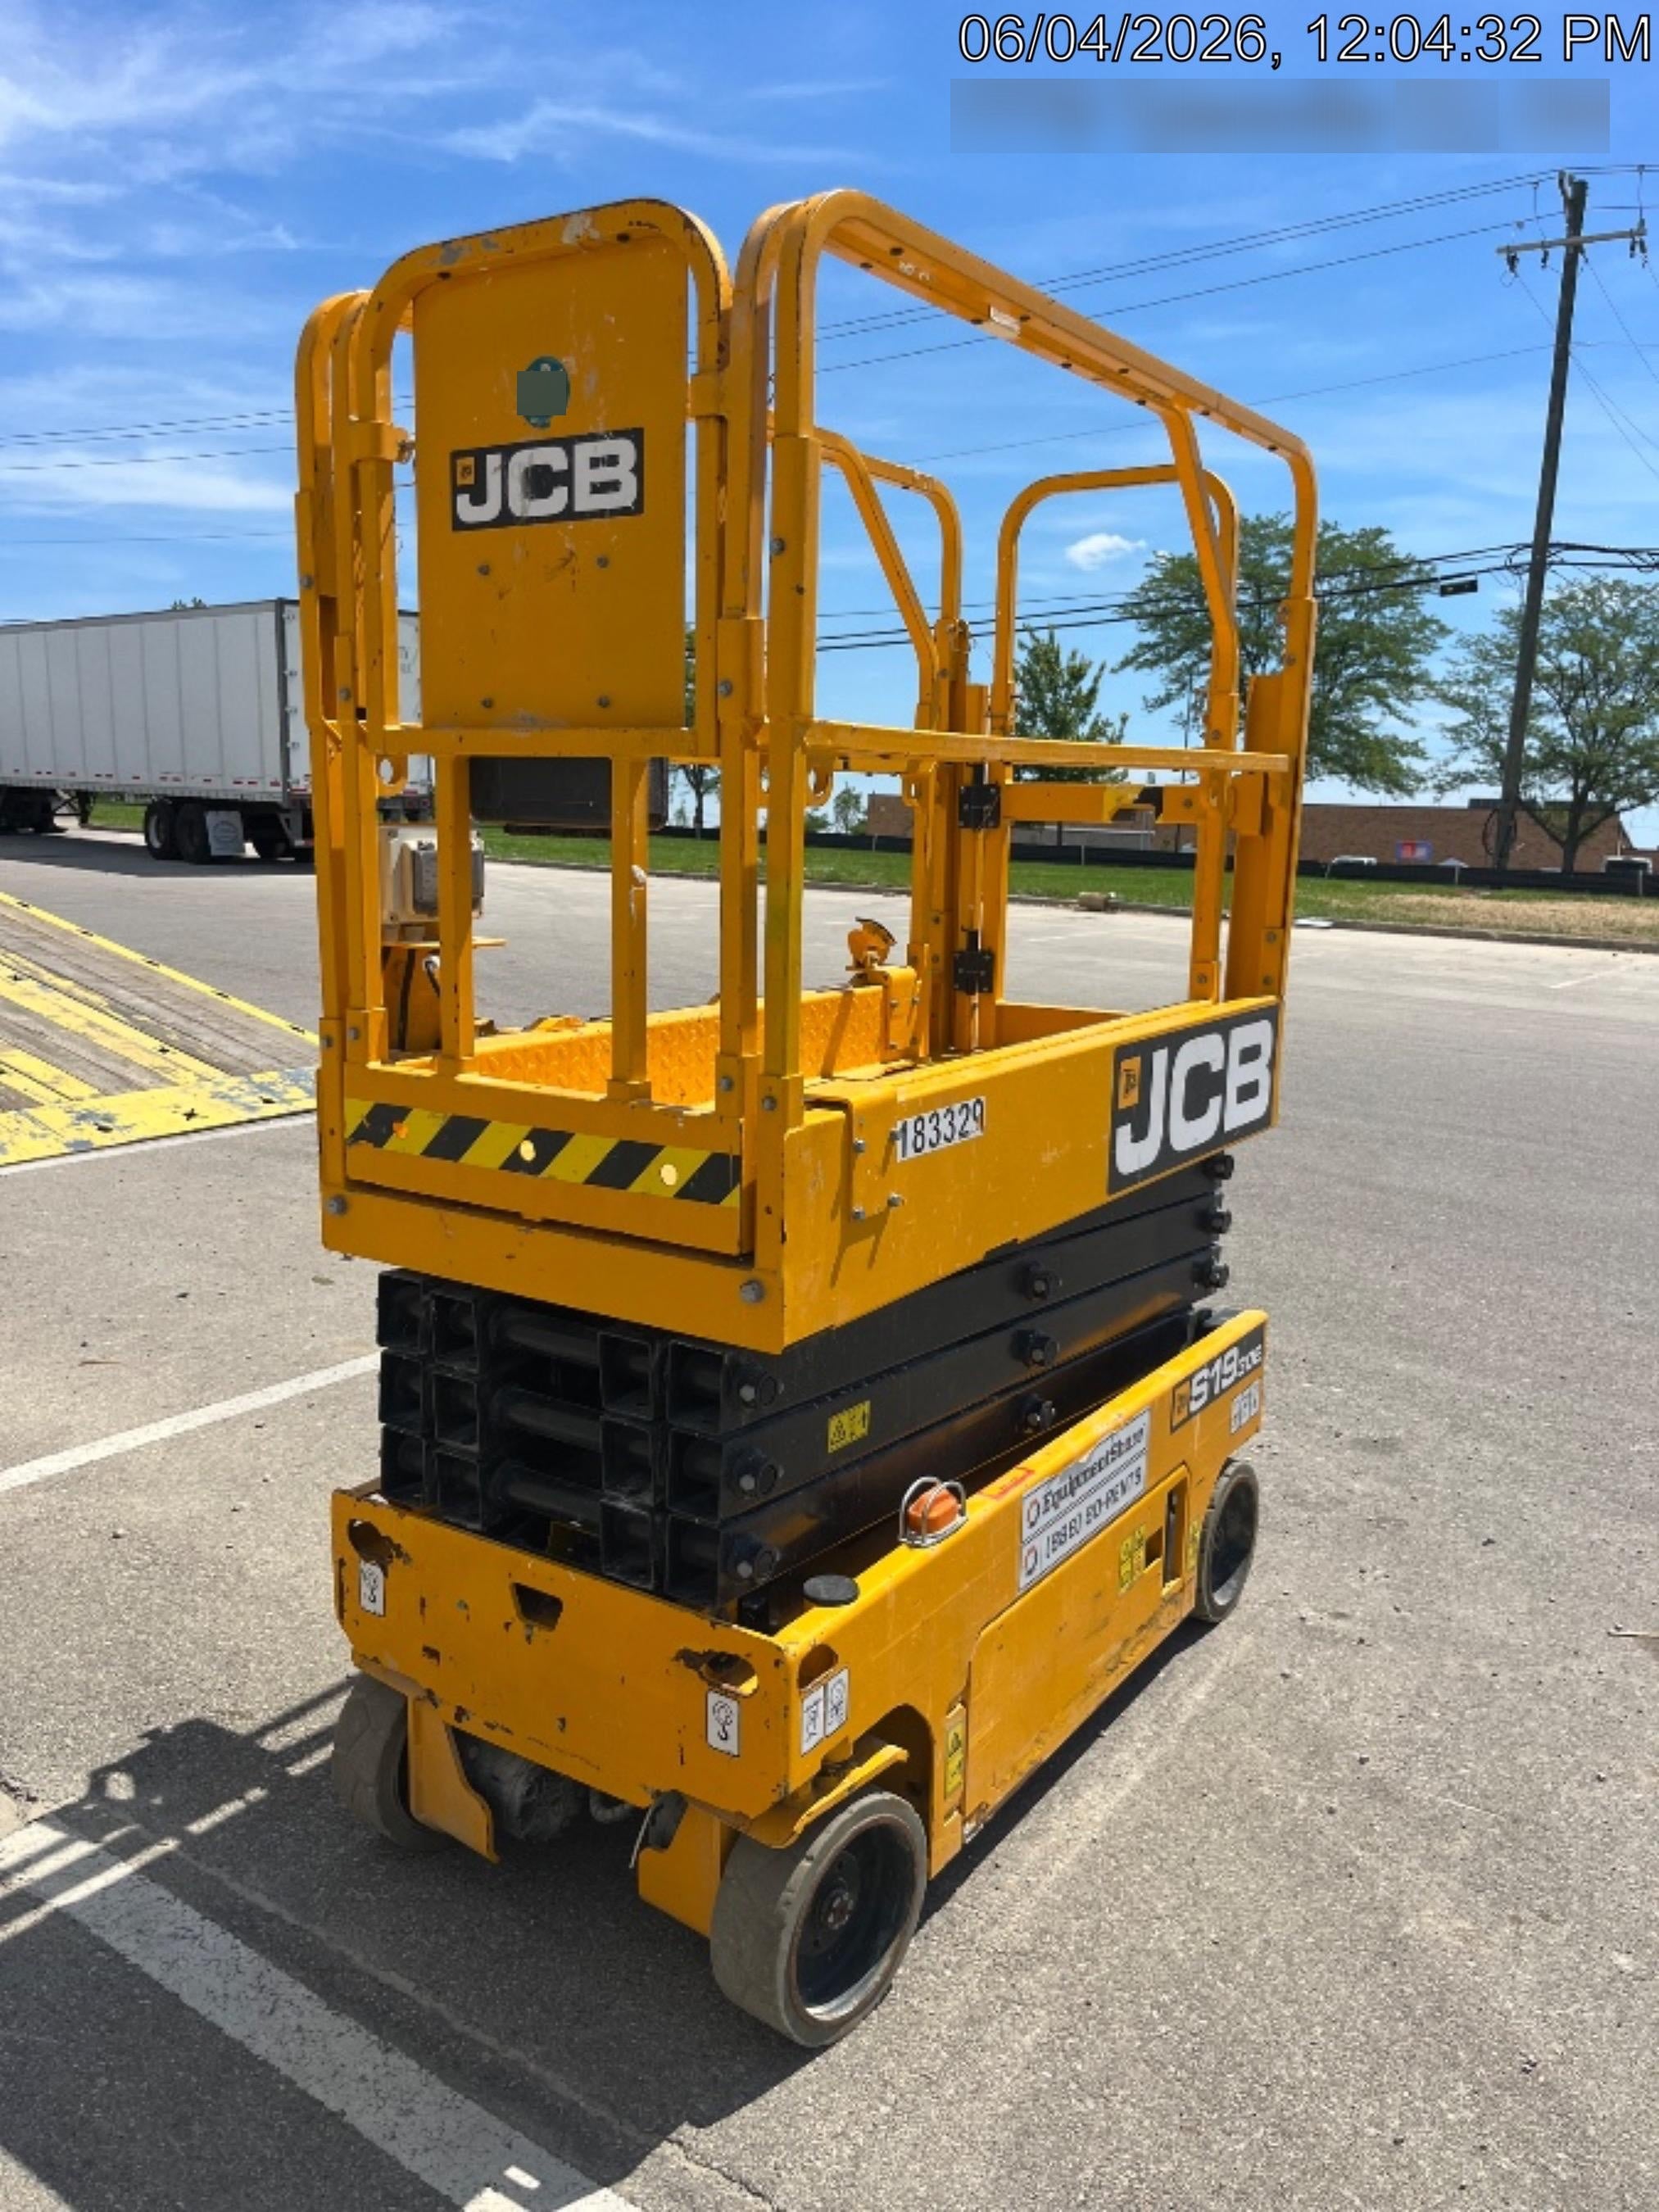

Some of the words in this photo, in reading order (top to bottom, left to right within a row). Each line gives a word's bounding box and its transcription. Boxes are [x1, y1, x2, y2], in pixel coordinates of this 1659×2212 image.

[456, 438, 637, 524] JCB
[900, 1098, 983, 1158] 183329
[1114, 1018, 1275, 1175] JCB
